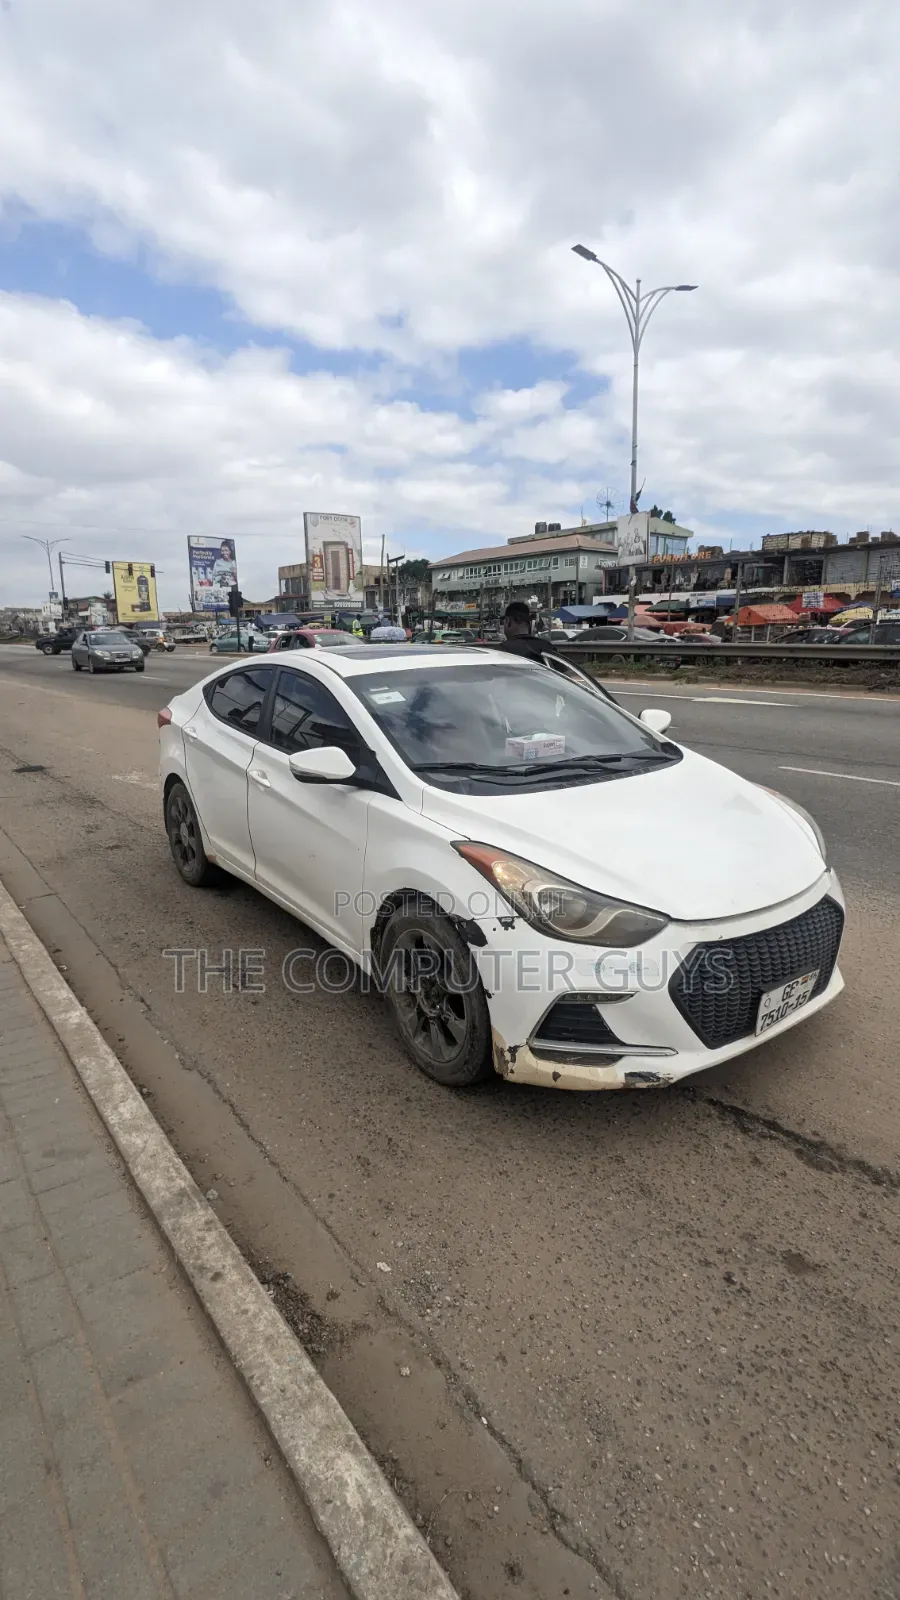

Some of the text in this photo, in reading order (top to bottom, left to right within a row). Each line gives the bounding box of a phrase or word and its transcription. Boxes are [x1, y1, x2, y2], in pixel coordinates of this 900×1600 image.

[314, 556, 321, 568] 3
[781, 980, 799, 1002] GE
[760, 989, 810, 1032] 7510-15
